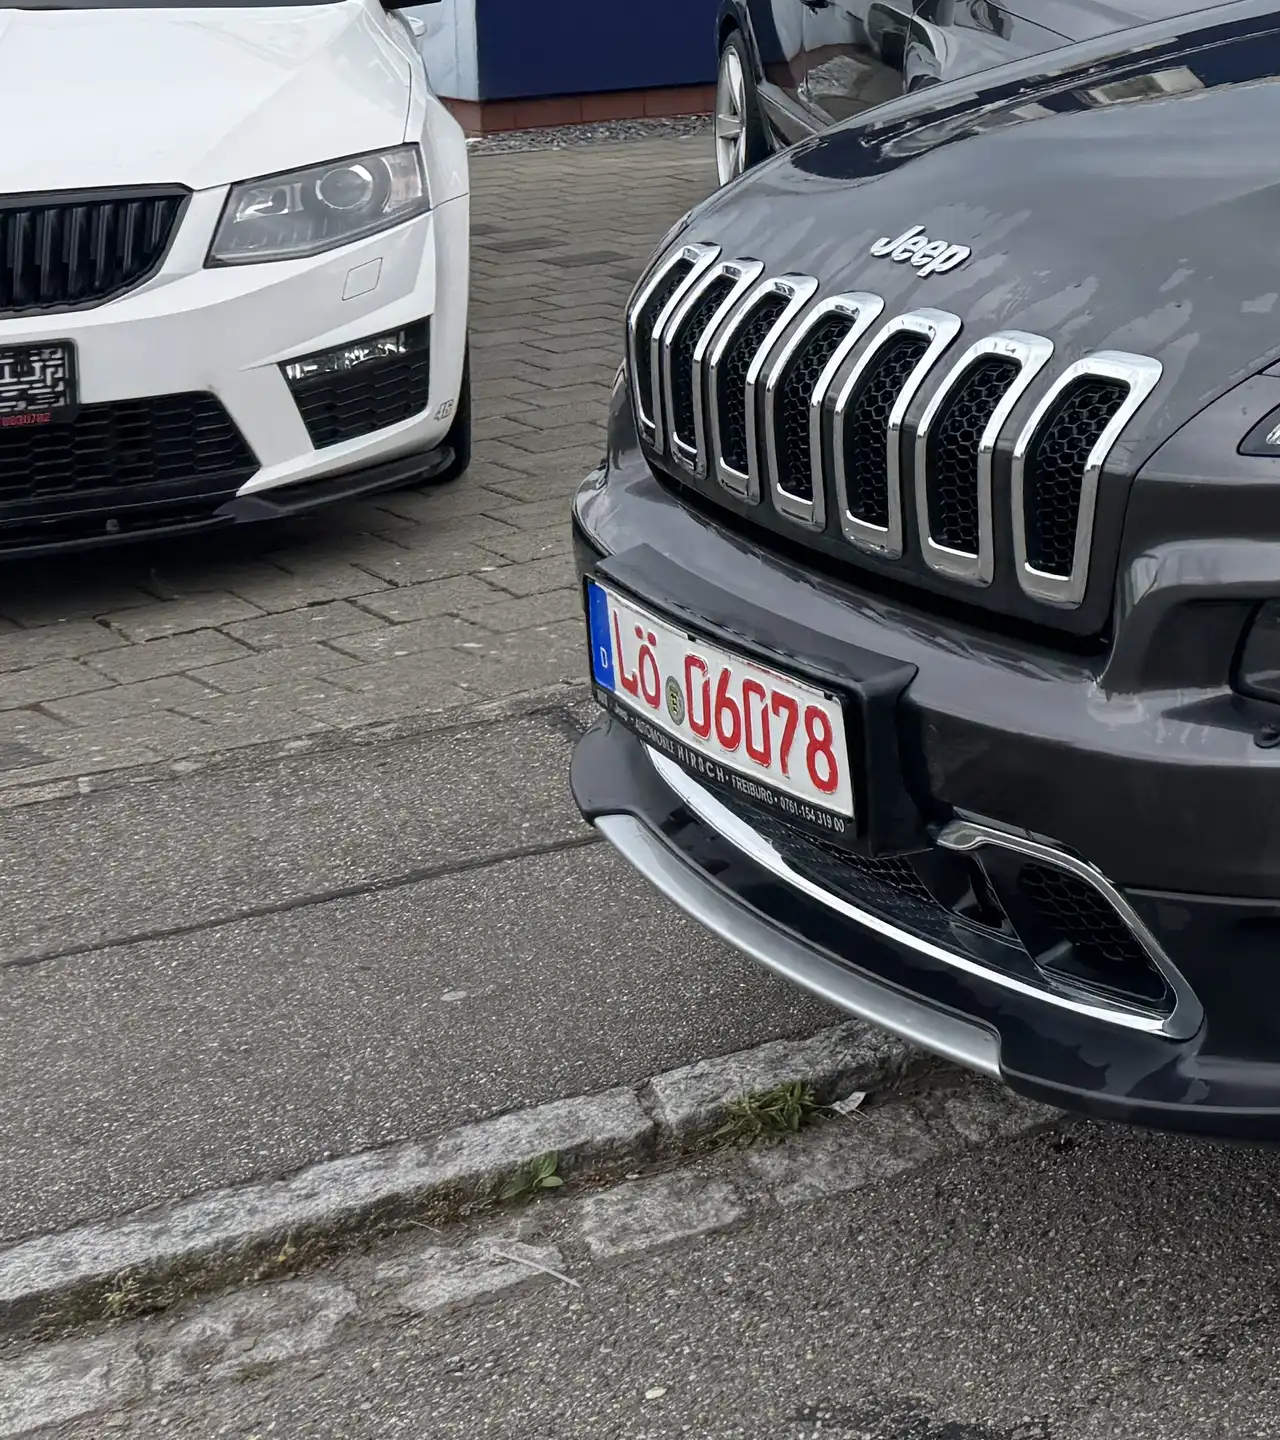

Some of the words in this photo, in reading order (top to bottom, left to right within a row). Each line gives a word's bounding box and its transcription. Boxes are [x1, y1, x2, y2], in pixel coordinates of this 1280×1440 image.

[869, 225, 971, 279] Jeep
[600, 646, 608, 669] D
[614, 609, 661, 709] LÖ
[685, 653, 839, 794] 06078
[677, 745, 724, 784] HIRSCH
[731, 773, 774, 805] FREIBURG
[817, 811, 832, 829] 319
